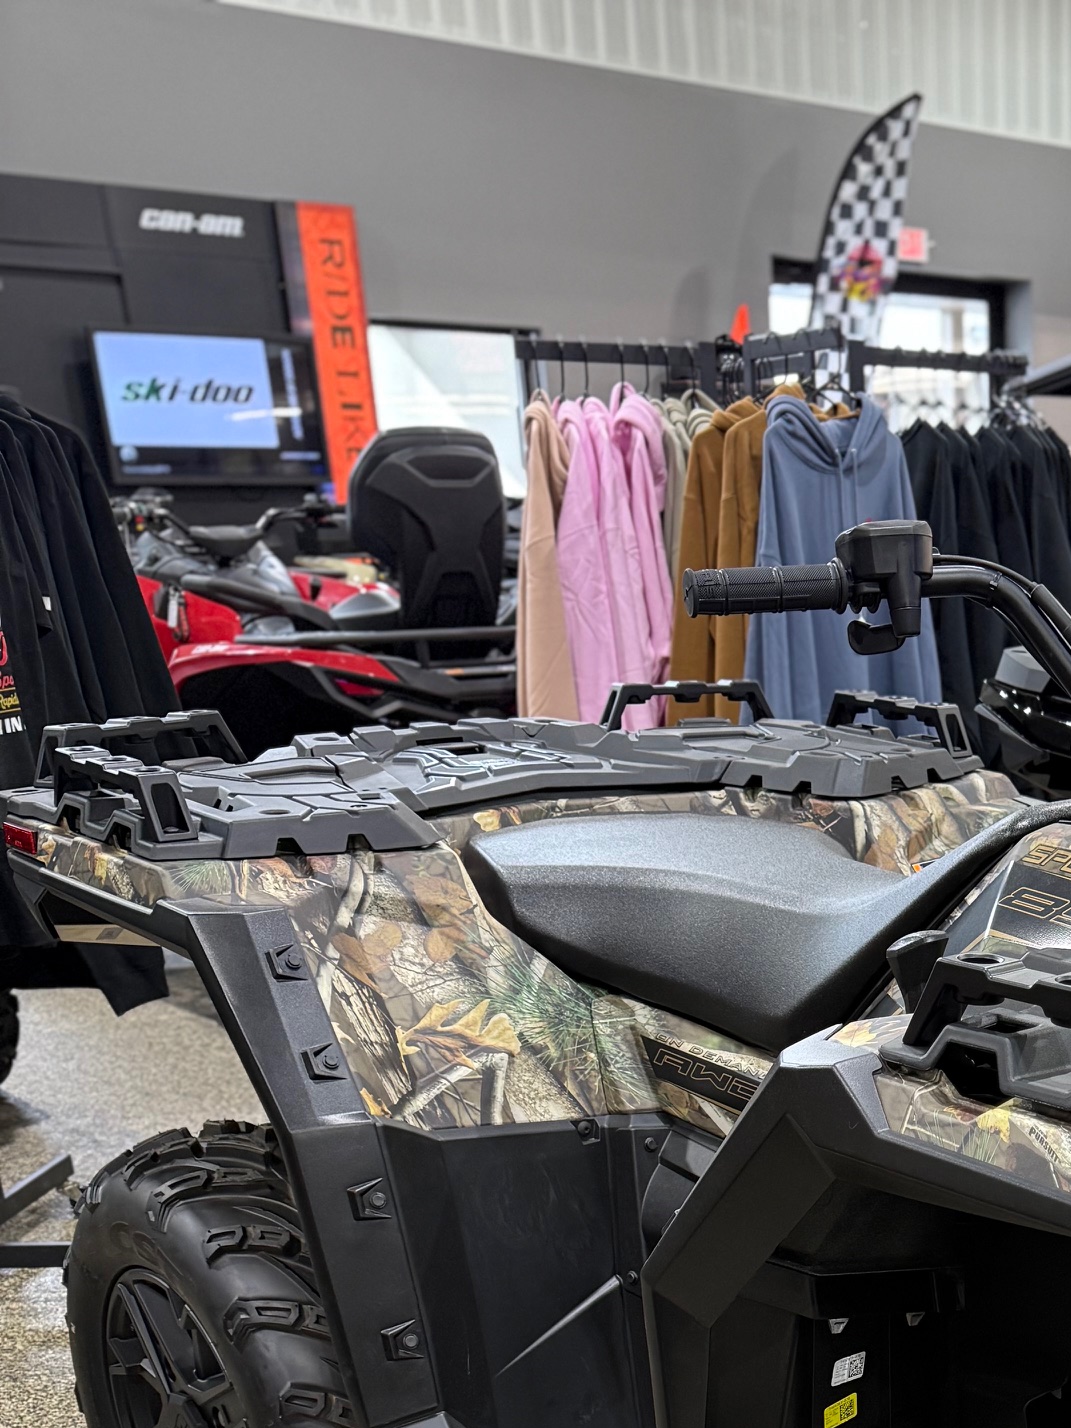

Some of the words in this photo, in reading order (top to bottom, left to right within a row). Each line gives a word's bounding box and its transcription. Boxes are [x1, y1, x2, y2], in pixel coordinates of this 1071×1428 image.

[319, 238, 355, 349] RIDE
[122, 377, 254, 404] ski-doo
[655, 1032, 685, 1048] ON
[689, 1044, 768, 1080] DEMAN
